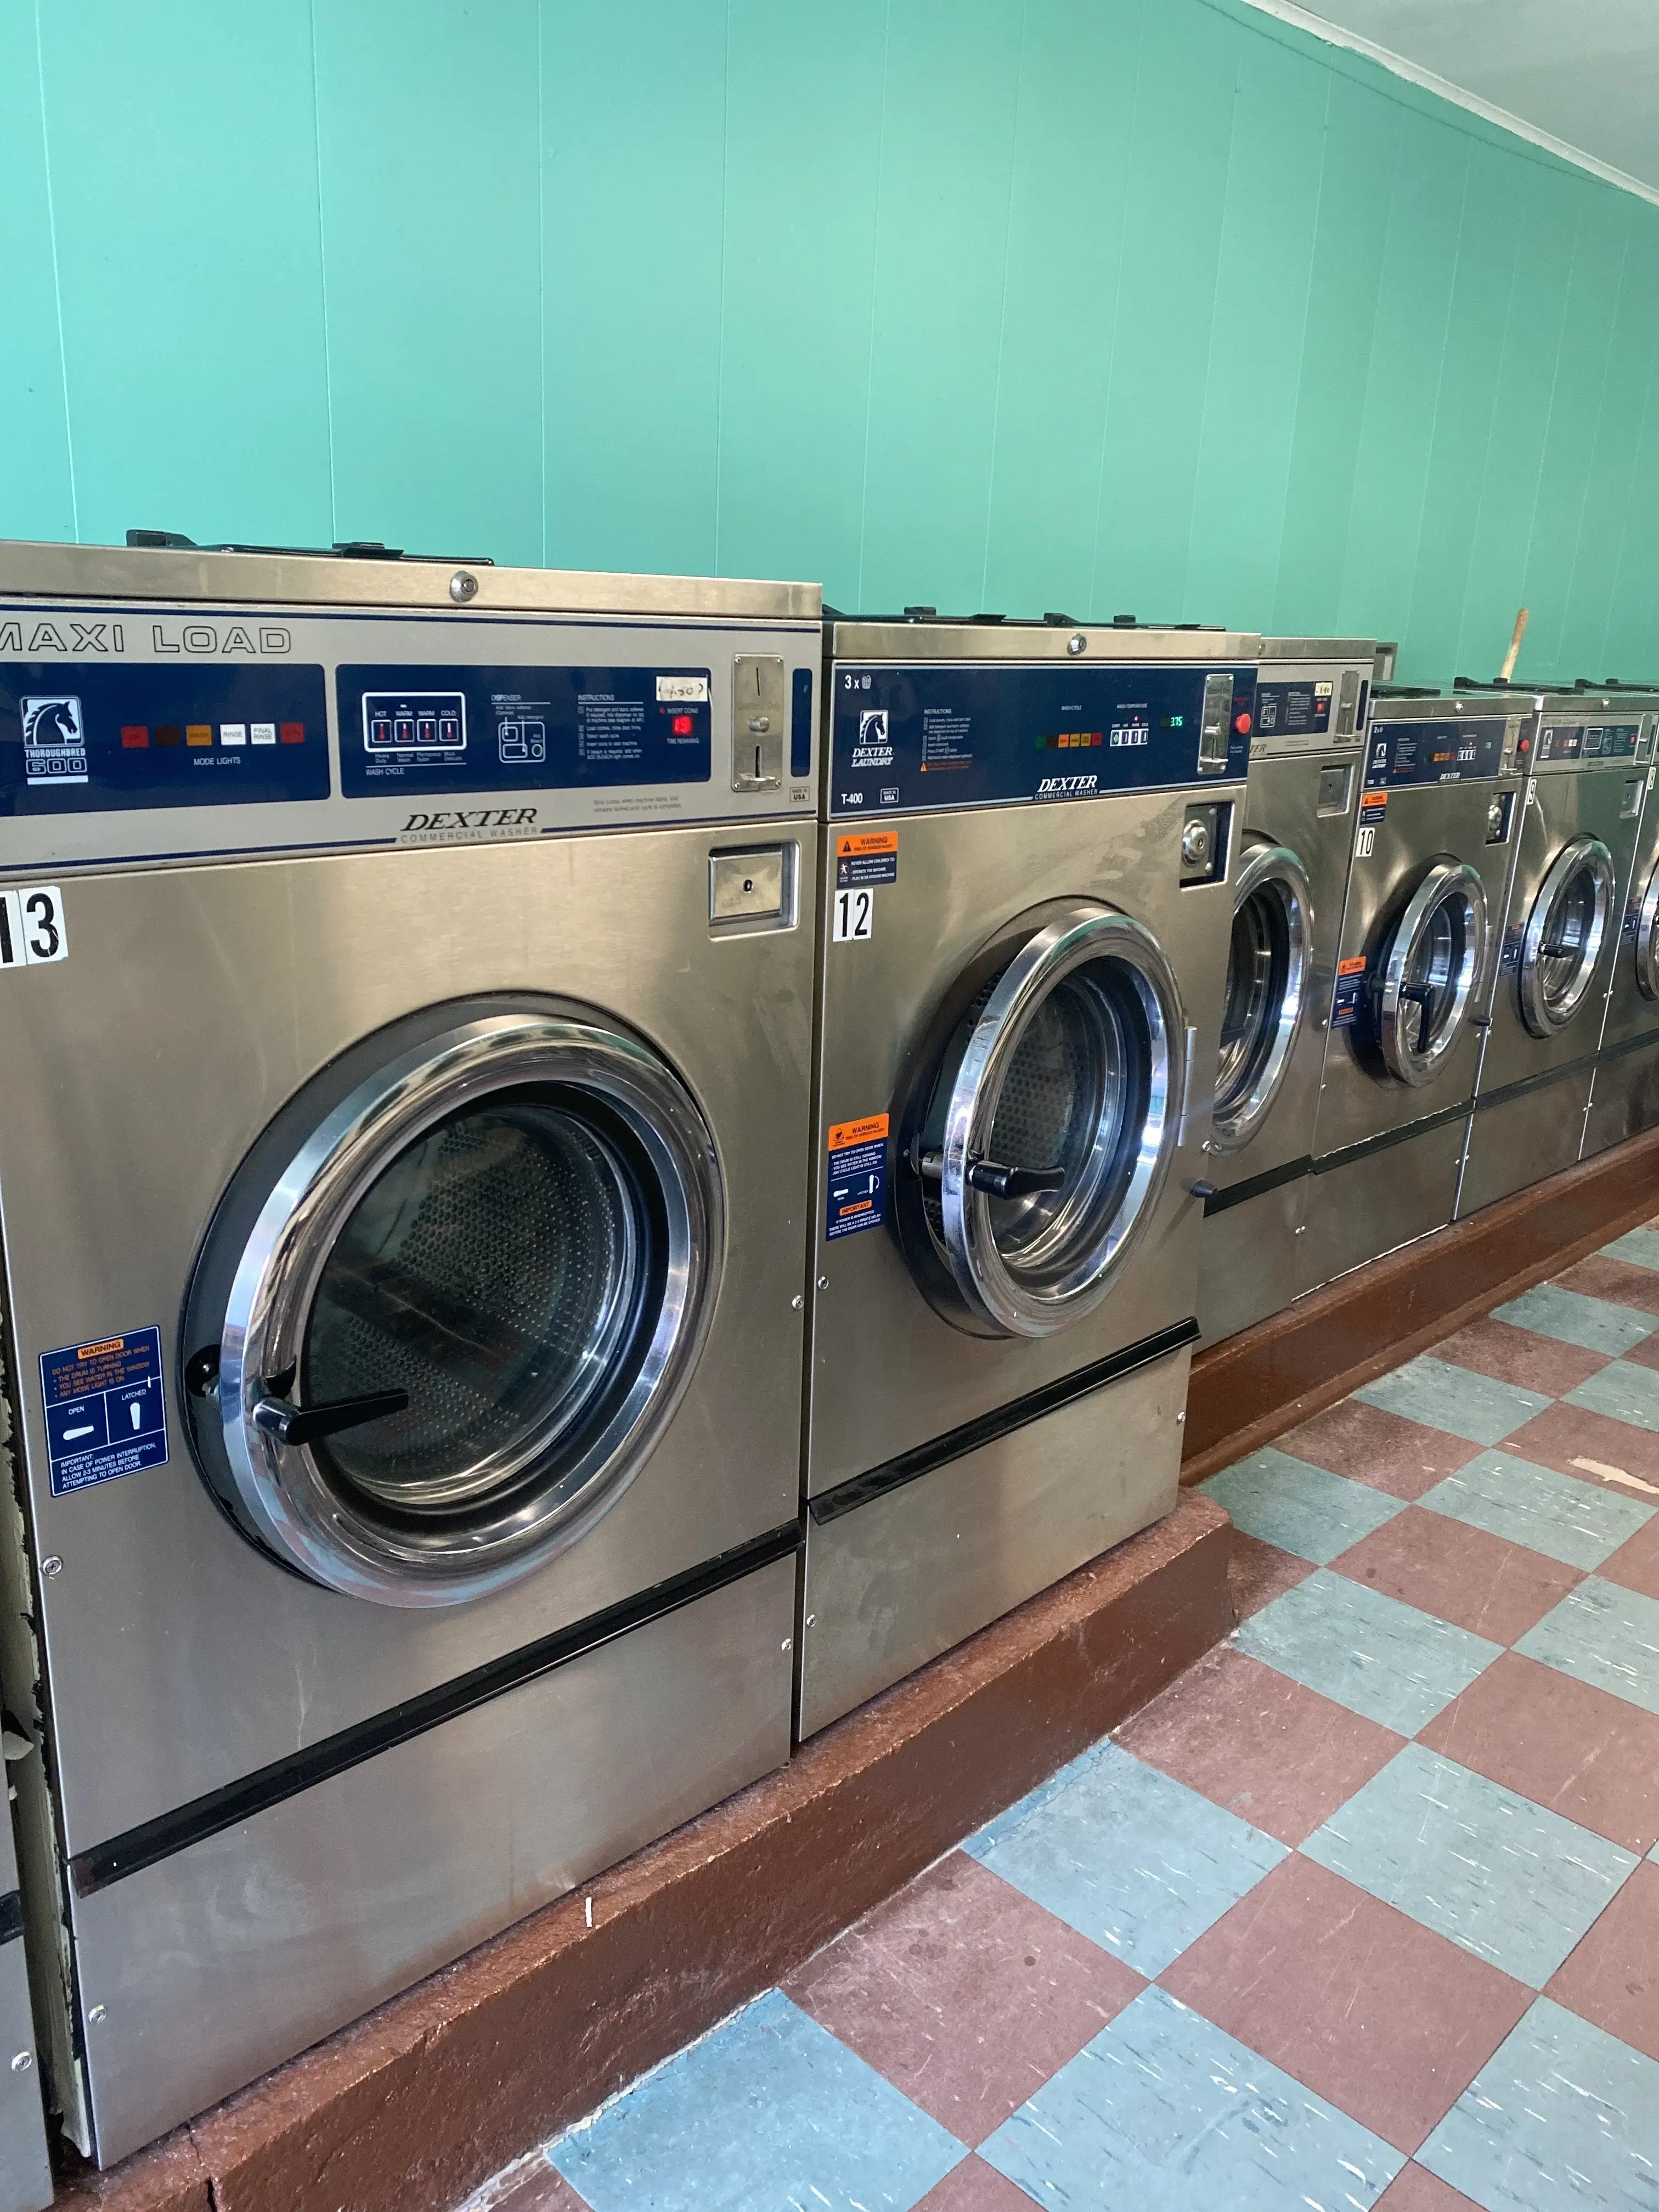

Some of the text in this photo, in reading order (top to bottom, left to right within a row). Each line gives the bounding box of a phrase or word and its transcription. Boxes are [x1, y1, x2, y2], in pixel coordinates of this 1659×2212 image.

[153, 625, 291, 653] LOAD
[844, 674, 860, 690] 3 x
[24, 748, 86, 758] THOROUGHBRED
[852, 747, 893, 758] DEXTER
[1250, 744, 1267, 753] TER
[26, 758, 87, 775] 600
[194, 757, 215, 765] MODE
[851, 757, 894, 768] LAUNDRY
[1037, 775, 1097, 793] DEXTER
[1529, 781, 1535, 803] 9
[841, 792, 863, 805] T-400
[1035, 791, 1073, 800] COMMERCIAL
[400, 808, 537, 831] DEXTER
[400, 827, 537, 843] COMMERCIAL WASHER
[860, 837, 888, 845] WARNING
[1360, 830, 1373, 855] 10
[839, 892, 869, 937] 12
[0, 893, 59, 963] 13
[852, 1122, 879, 1133] WARNING
[842, 1201, 870, 1214] IMPORTANT
[81, 1341, 121, 1356] WARNING
[62, 1364, 74, 1373] NOT
[98, 1355, 114, 1363] OPEN
[115, 1350, 132, 1359] DOOR
[133, 1345, 150, 1354] WHEN
[59, 1381, 72, 1390] YOU
[85, 1373, 105, 1383] WATER
[114, 1367, 125, 1375] THE
[126, 1361, 150, 1372] WINDOW
[71, 1369, 88, 1379] DRUM
[97, 1361, 121, 1372] TURNING
[59, 1389, 71, 1398] ANY
[73, 1384, 89, 1393] MODE
[91, 1379, 107, 1389] LIGHT
[121, 1389, 146, 1401] LATCHED
[68, 1405, 84, 1415] OPEN
[62, 1471, 82, 1482] ALLOW
[92, 1461, 116, 1473] MINUTES
[117, 1454, 139, 1465] BEFORE
[69, 1463, 84, 1473] CASE
[94, 1454, 115, 1465] POWER
[63, 1474, 98, 1489] ATTEMPTING
[108, 1465, 123, 1475] OPEN
